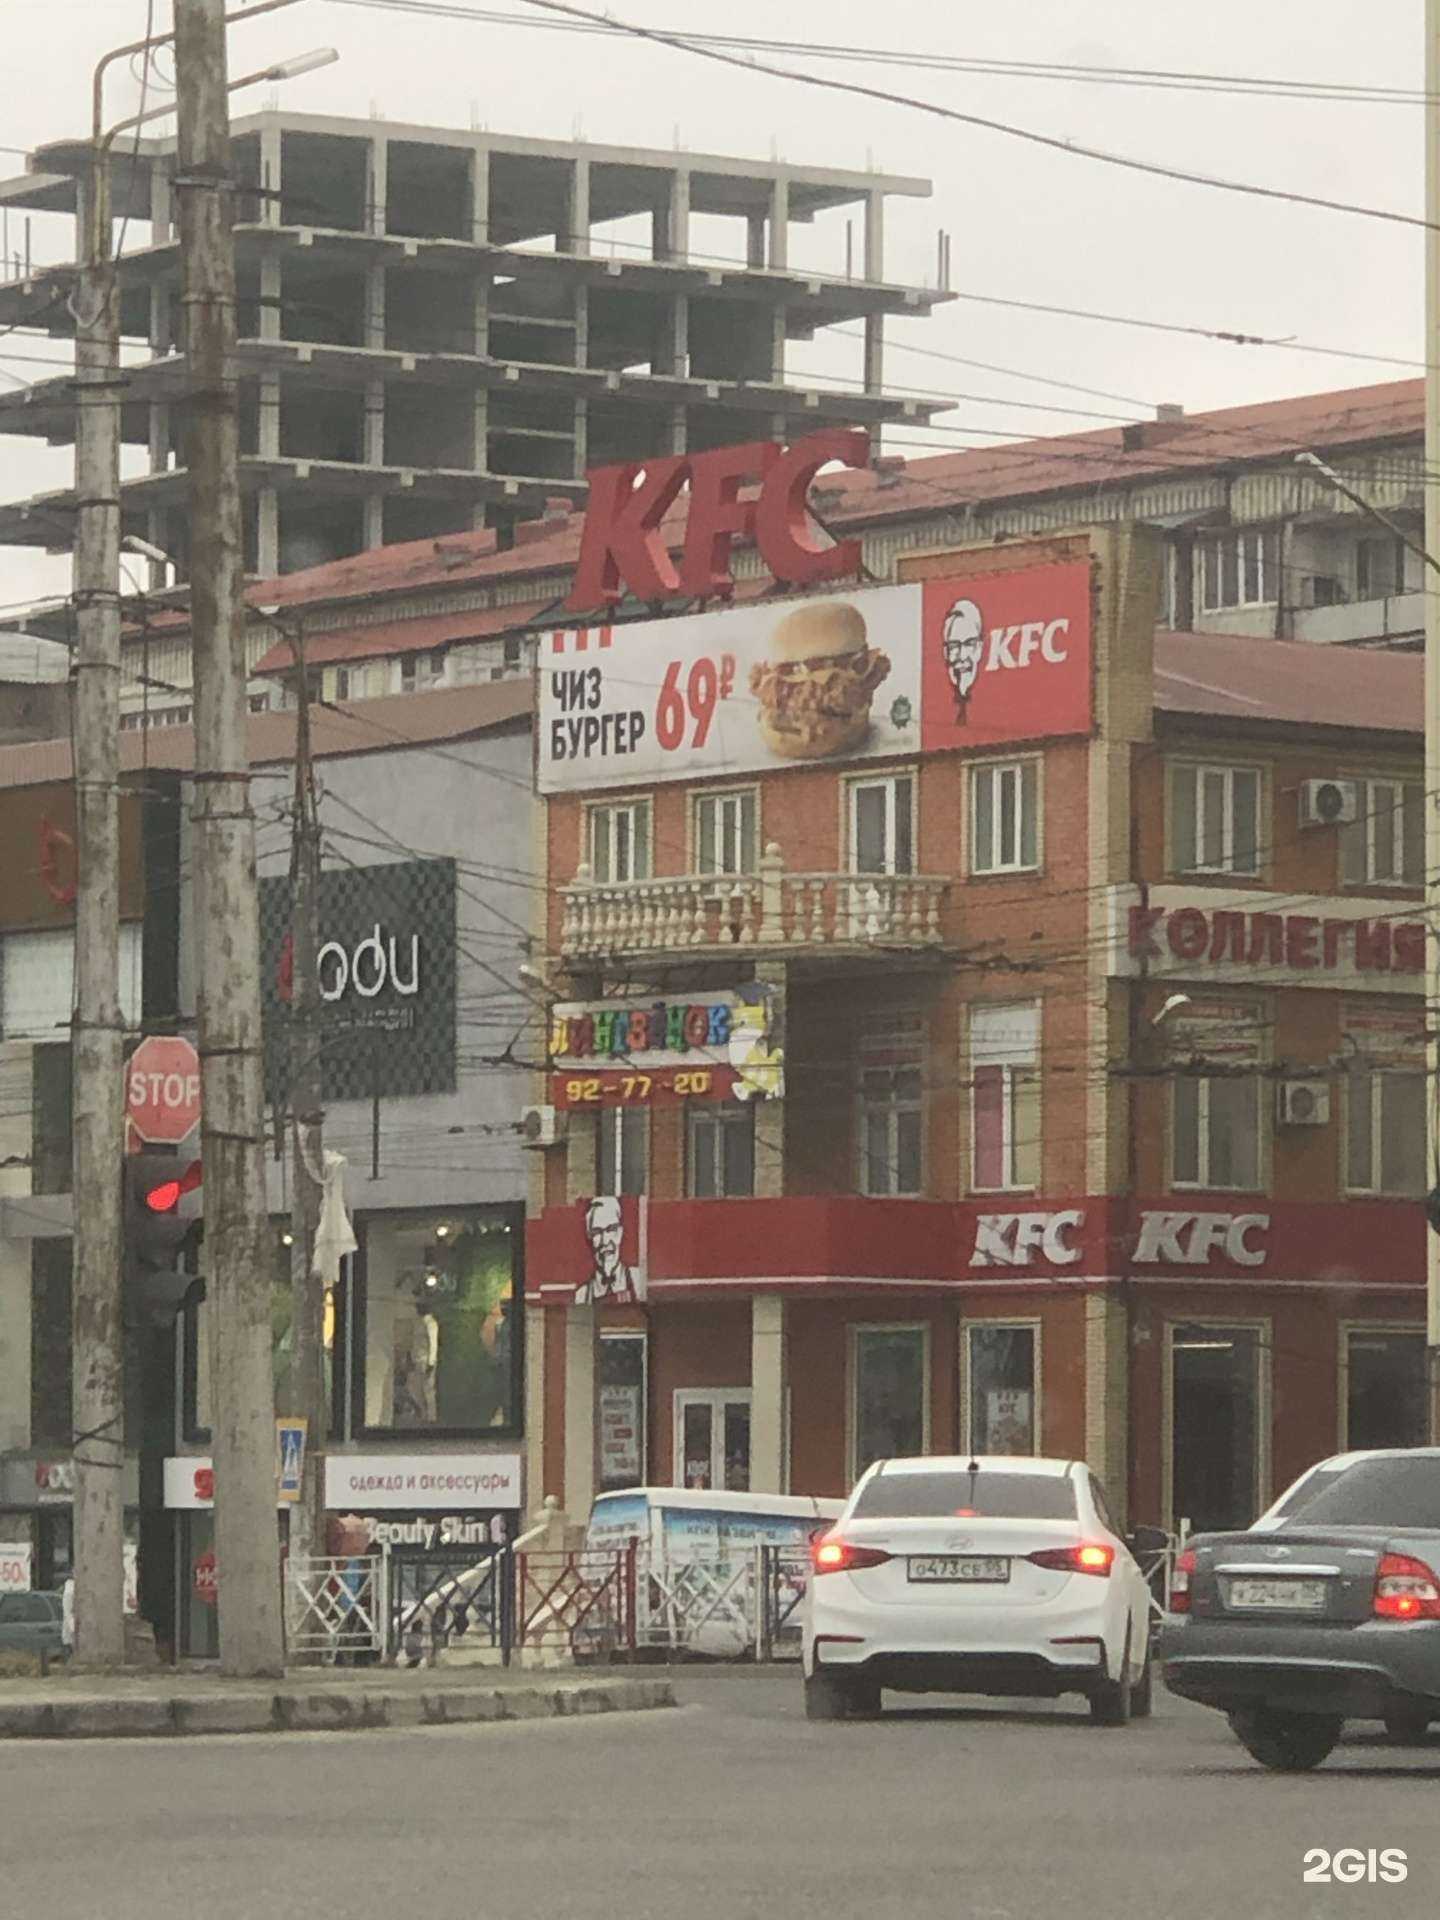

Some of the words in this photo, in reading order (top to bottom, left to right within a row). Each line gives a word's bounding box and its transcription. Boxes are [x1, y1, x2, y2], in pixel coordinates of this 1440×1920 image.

[565, 426, 870, 611] KFC
[985, 618, 1069, 672] KFC
[551, 666, 602, 712] ЧИЗ
[551, 710, 645, 761] БУРГЕР
[129, 1072, 200, 1107] STOP
[969, 1210, 1083, 1267] KFC
[1131, 1210, 1270, 1266] KFC
[350, 1475, 402, 1491] одежда
[420, 1474, 510, 1493] аксессуары
[440, 1516, 486, 1545] Skin
